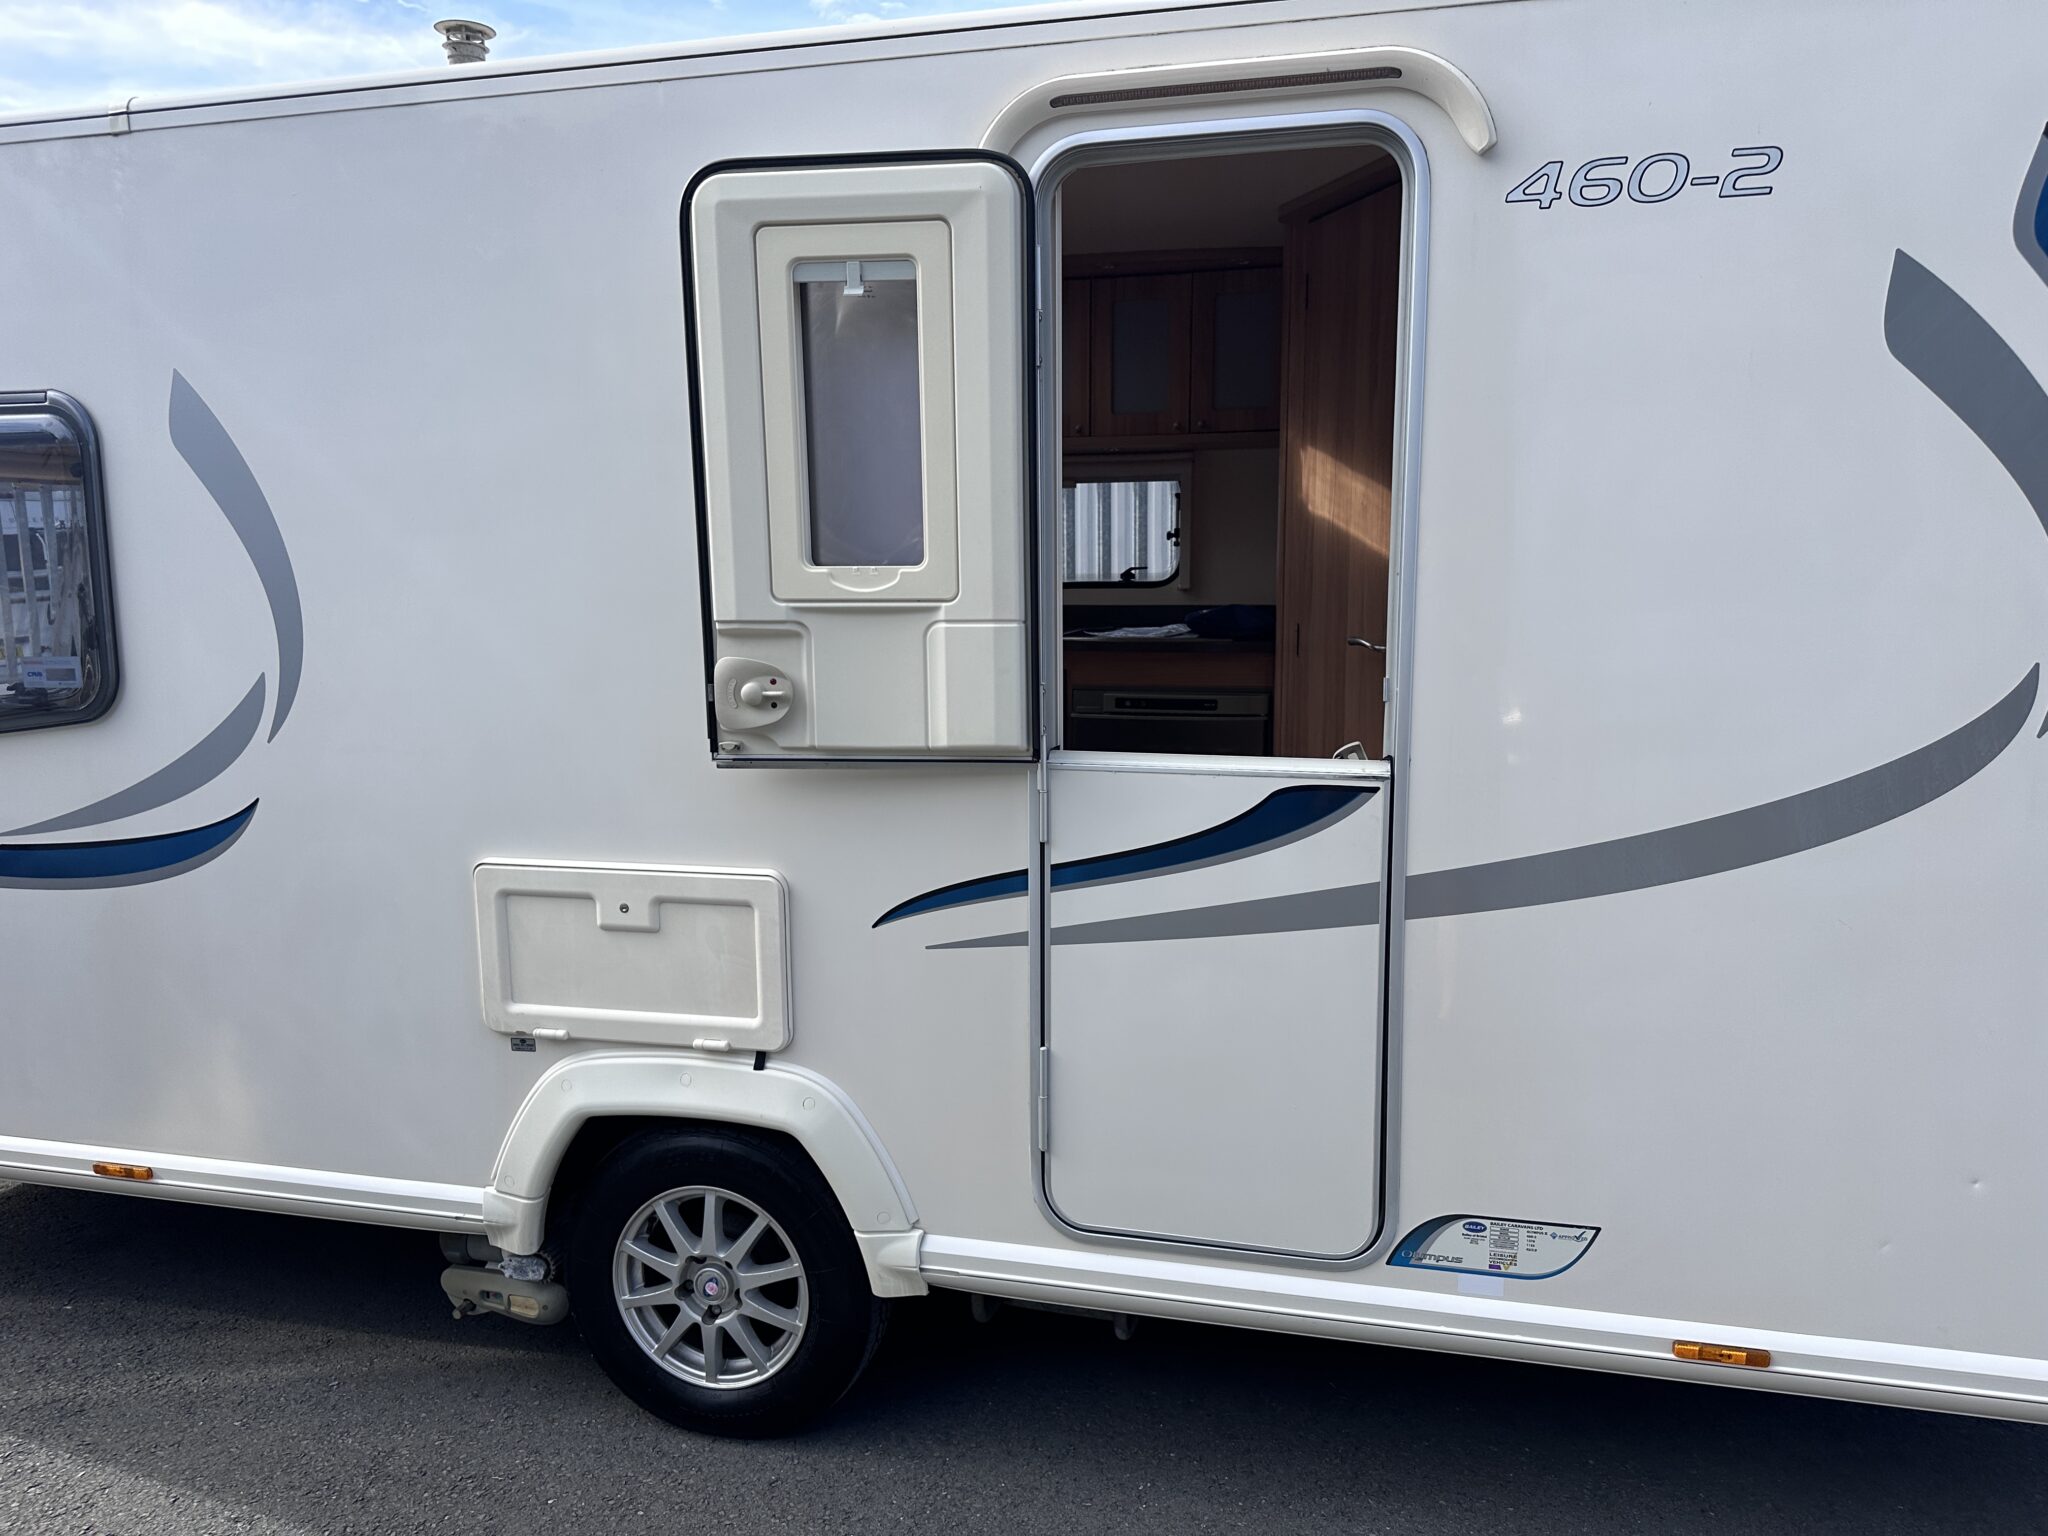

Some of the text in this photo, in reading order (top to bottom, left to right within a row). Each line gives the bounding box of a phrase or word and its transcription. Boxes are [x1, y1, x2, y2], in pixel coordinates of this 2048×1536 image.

[1505, 145, 1784, 210] 460-2
[1489, 1252, 1518, 1260] LEISURE
[1489, 1259, 1518, 1267] VEHICLES
